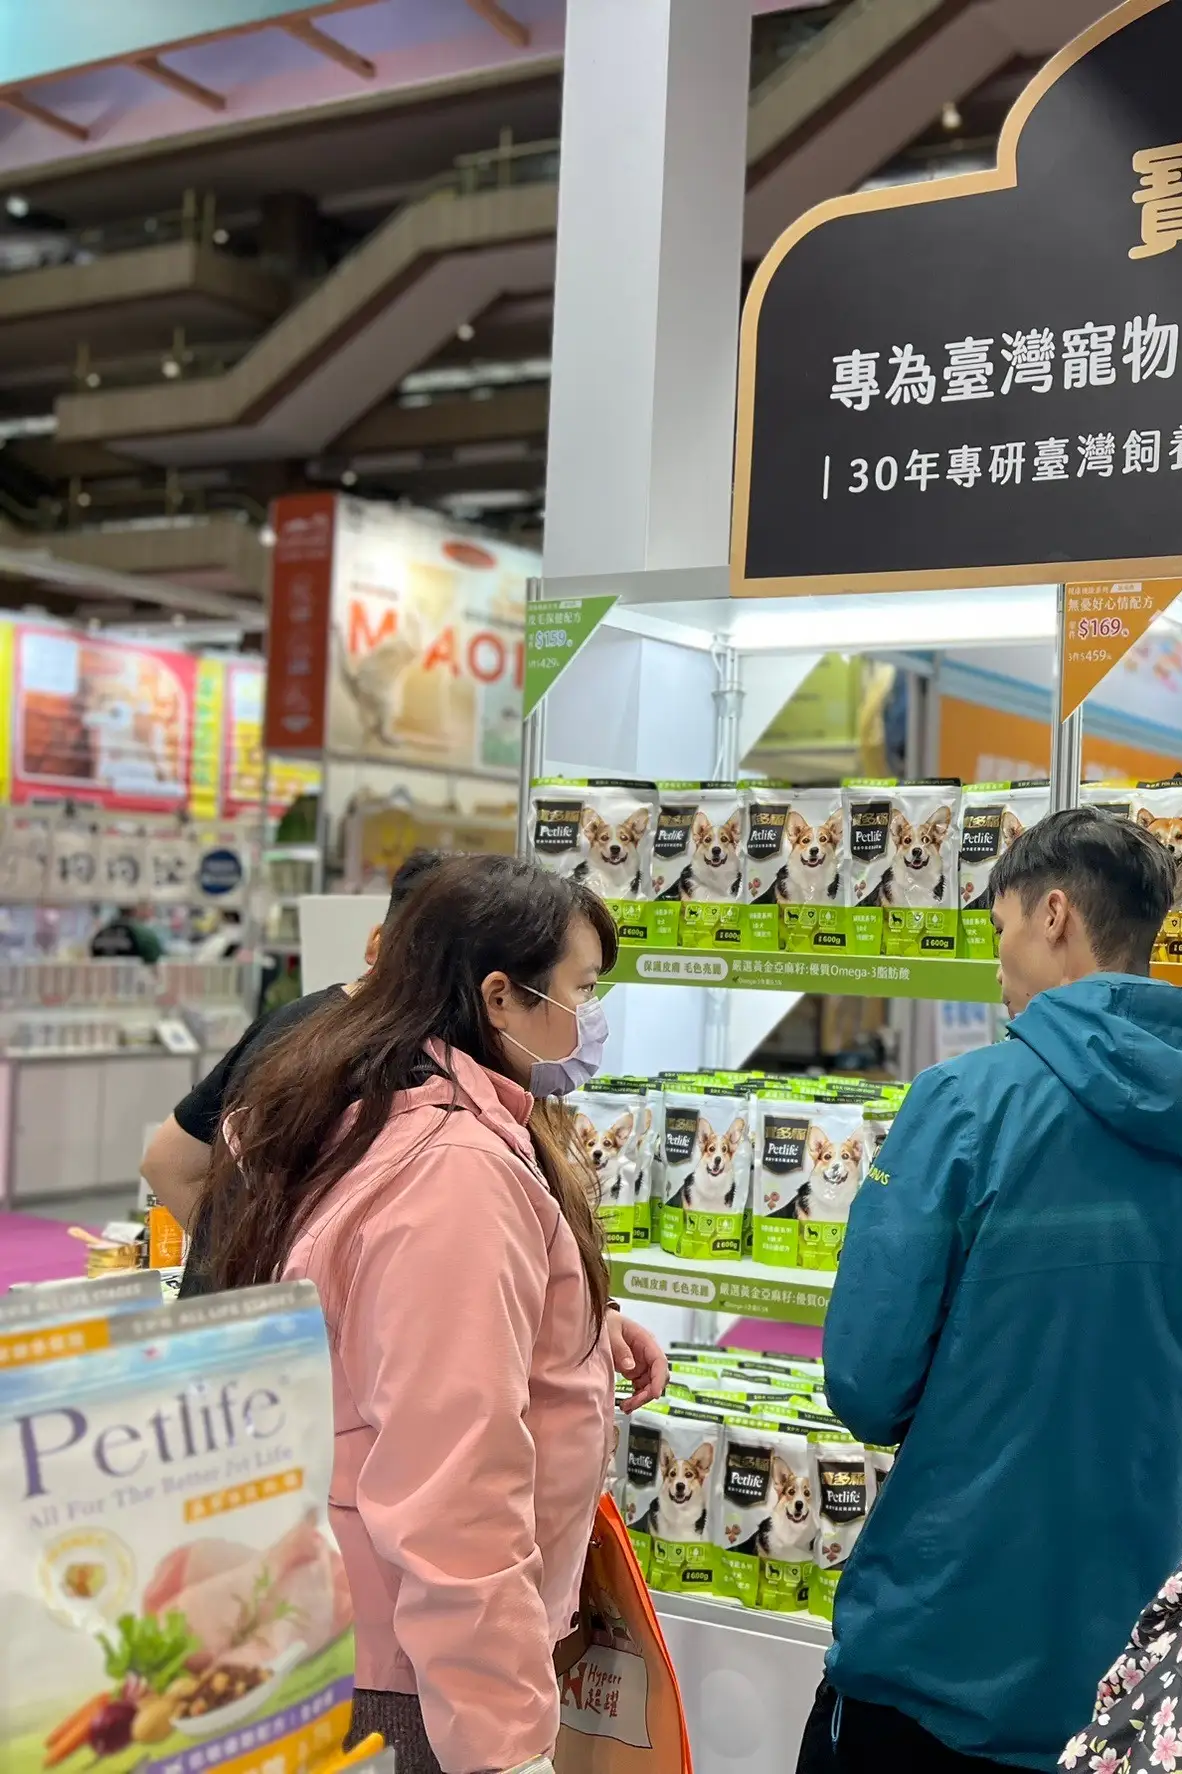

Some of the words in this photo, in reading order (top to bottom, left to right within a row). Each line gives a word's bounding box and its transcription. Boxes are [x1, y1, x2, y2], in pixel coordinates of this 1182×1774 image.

[855, 830, 883, 843] Petlife
[962, 832, 993, 845] Petlife
[14, 1379, 286, 1499] Petlife
